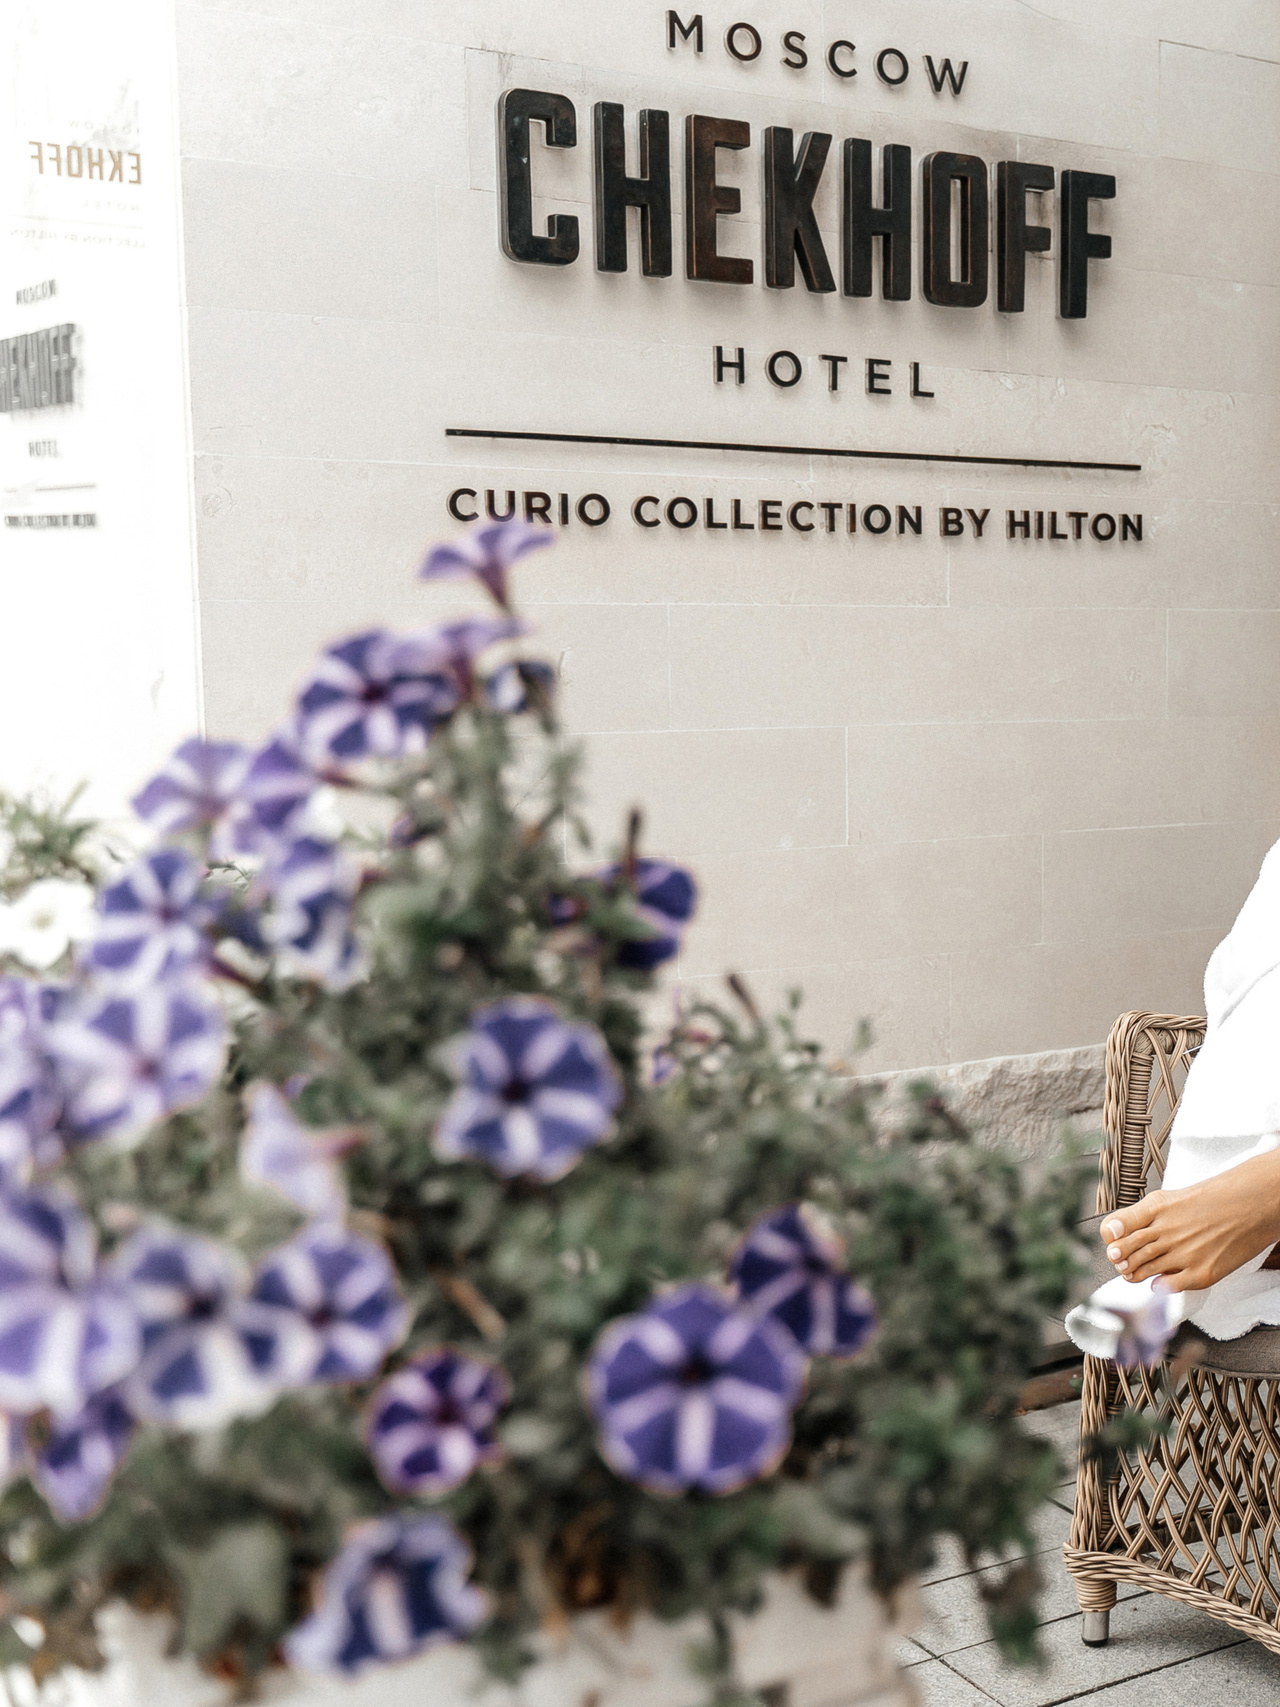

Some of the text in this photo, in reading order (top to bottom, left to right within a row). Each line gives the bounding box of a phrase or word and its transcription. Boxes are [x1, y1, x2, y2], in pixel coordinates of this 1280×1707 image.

[666, 10, 969, 95] MOSCOW
[498, 87, 1116, 320] CHEKHOFF
[712, 345, 934, 399] HOTEL
[447, 487, 1144, 542] CURIO COLLECTION BY HILTON
